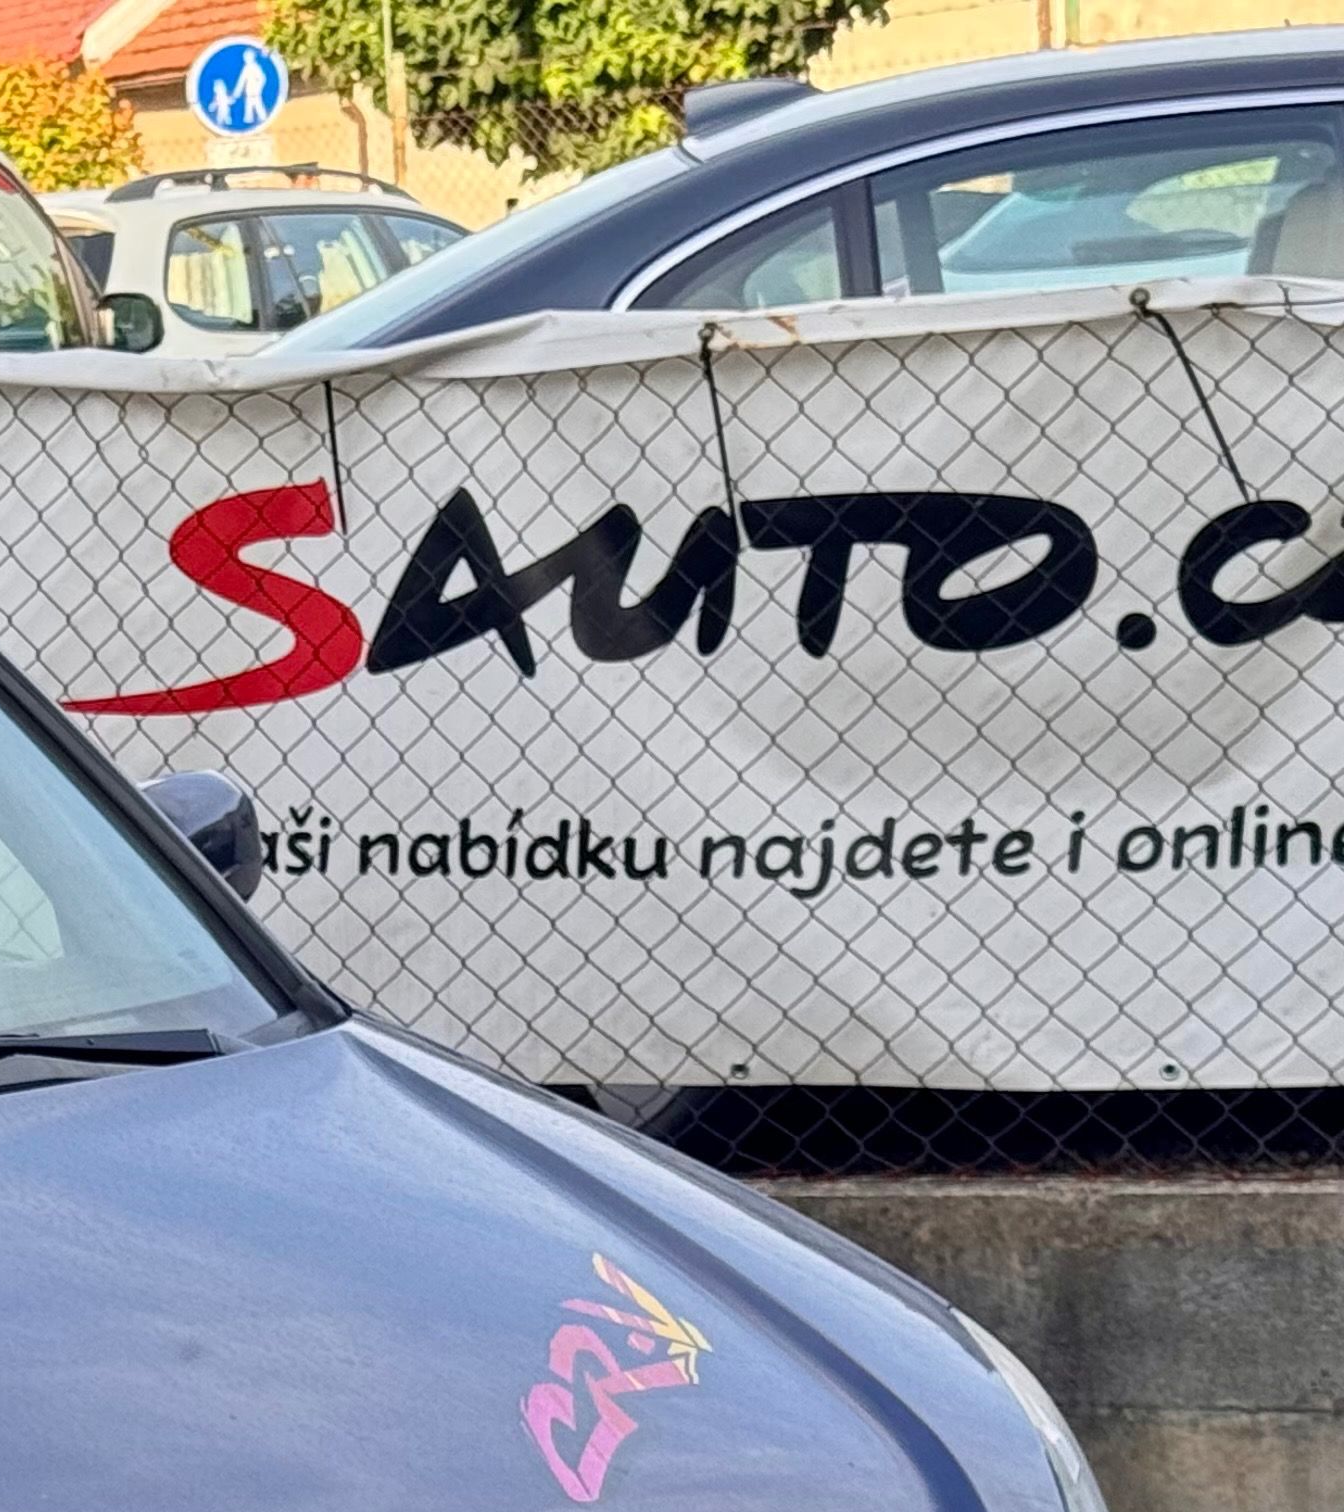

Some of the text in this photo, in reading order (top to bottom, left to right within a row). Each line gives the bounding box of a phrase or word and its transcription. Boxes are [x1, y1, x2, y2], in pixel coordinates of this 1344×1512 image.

[359, 808, 668, 880] nabídku
[699, 816, 1034, 899] najdete
[1067, 810, 1086, 874] i
